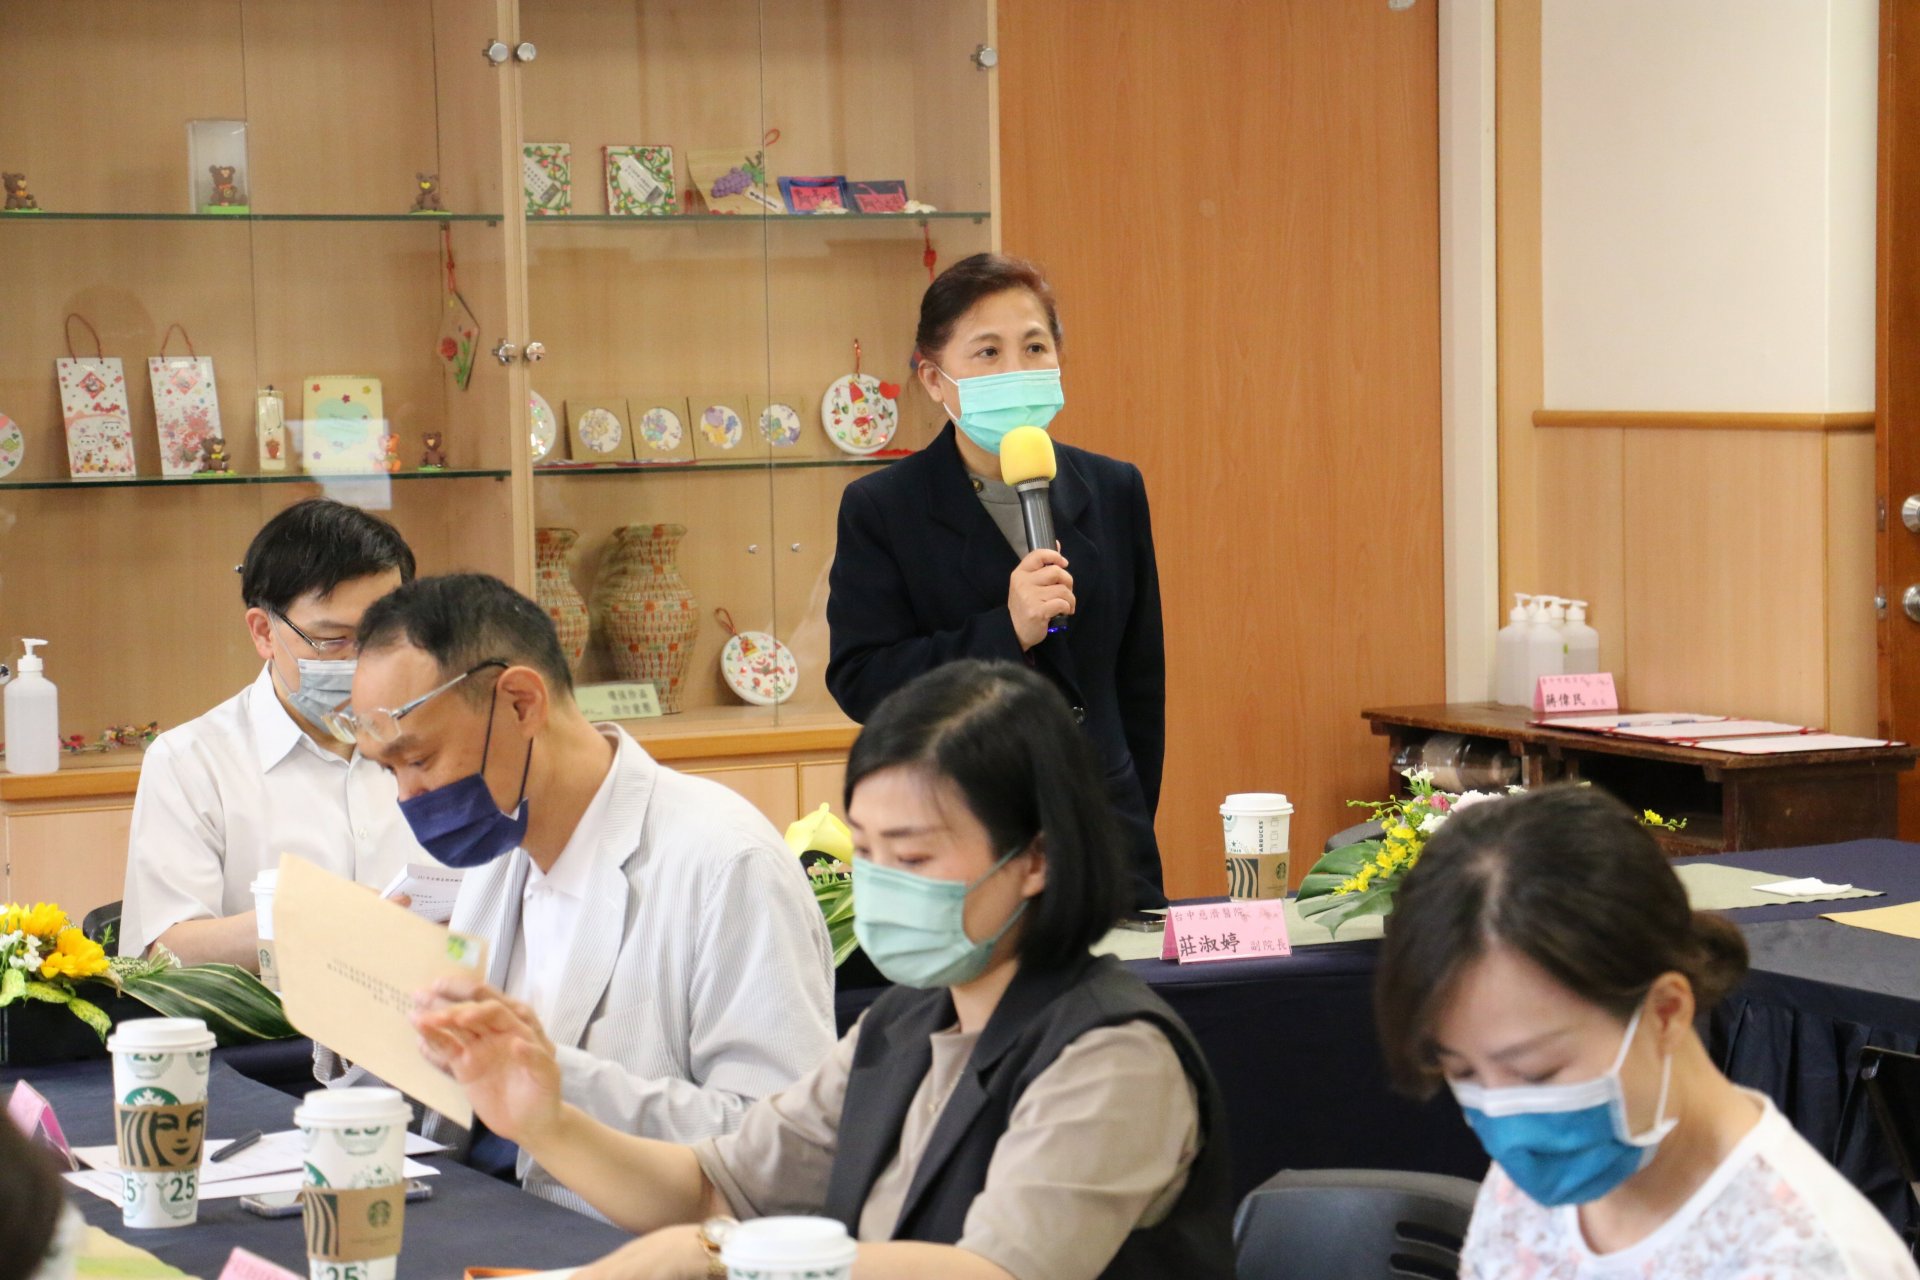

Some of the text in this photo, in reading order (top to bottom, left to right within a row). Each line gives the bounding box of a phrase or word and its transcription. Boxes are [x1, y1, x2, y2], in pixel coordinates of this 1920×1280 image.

[1174, 907, 1243, 922] 台中慈濟醫院
[1179, 932, 1288, 957] 莊淑婷 副院長
[169, 1174, 195, 1202] 25
